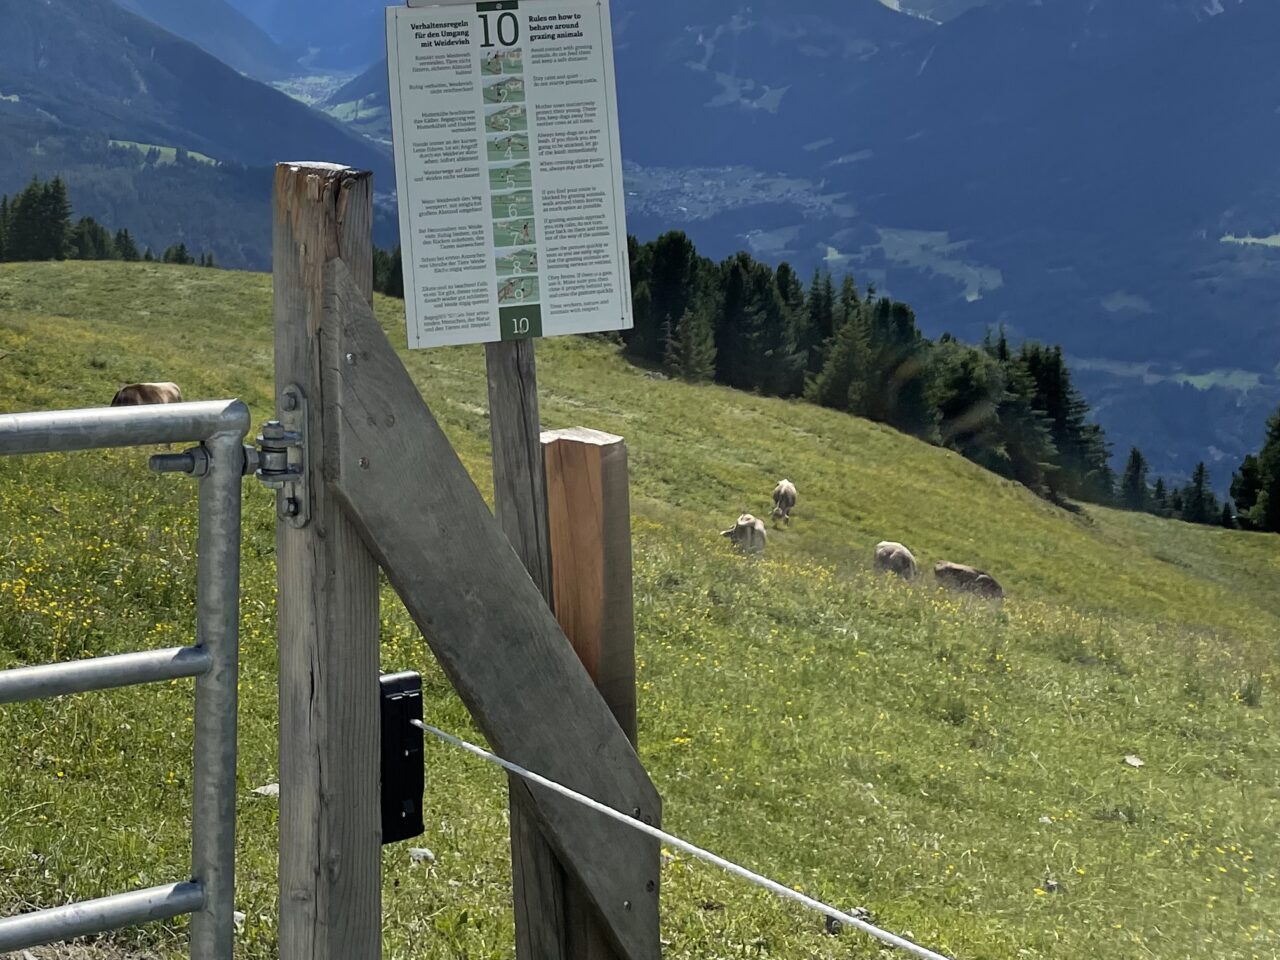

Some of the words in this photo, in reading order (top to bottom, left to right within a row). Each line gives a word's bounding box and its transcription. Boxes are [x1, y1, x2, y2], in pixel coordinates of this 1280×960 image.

[410, 20, 469, 31] Verhaltensregeln
[478, 12, 520, 47] 10
[529, 23, 553, 32] behave
[554, 22, 579, 30] around
[440, 29, 469, 39] Umgang
[530, 33, 556, 42] grazing
[434, 38, 470, 47] Weidevieh
[507, 175, 515, 189] 5
[508, 203, 517, 218] 6
[511, 232, 520, 246] 7
[513, 261, 522, 275] 8
[512, 318, 530, 334] 10
